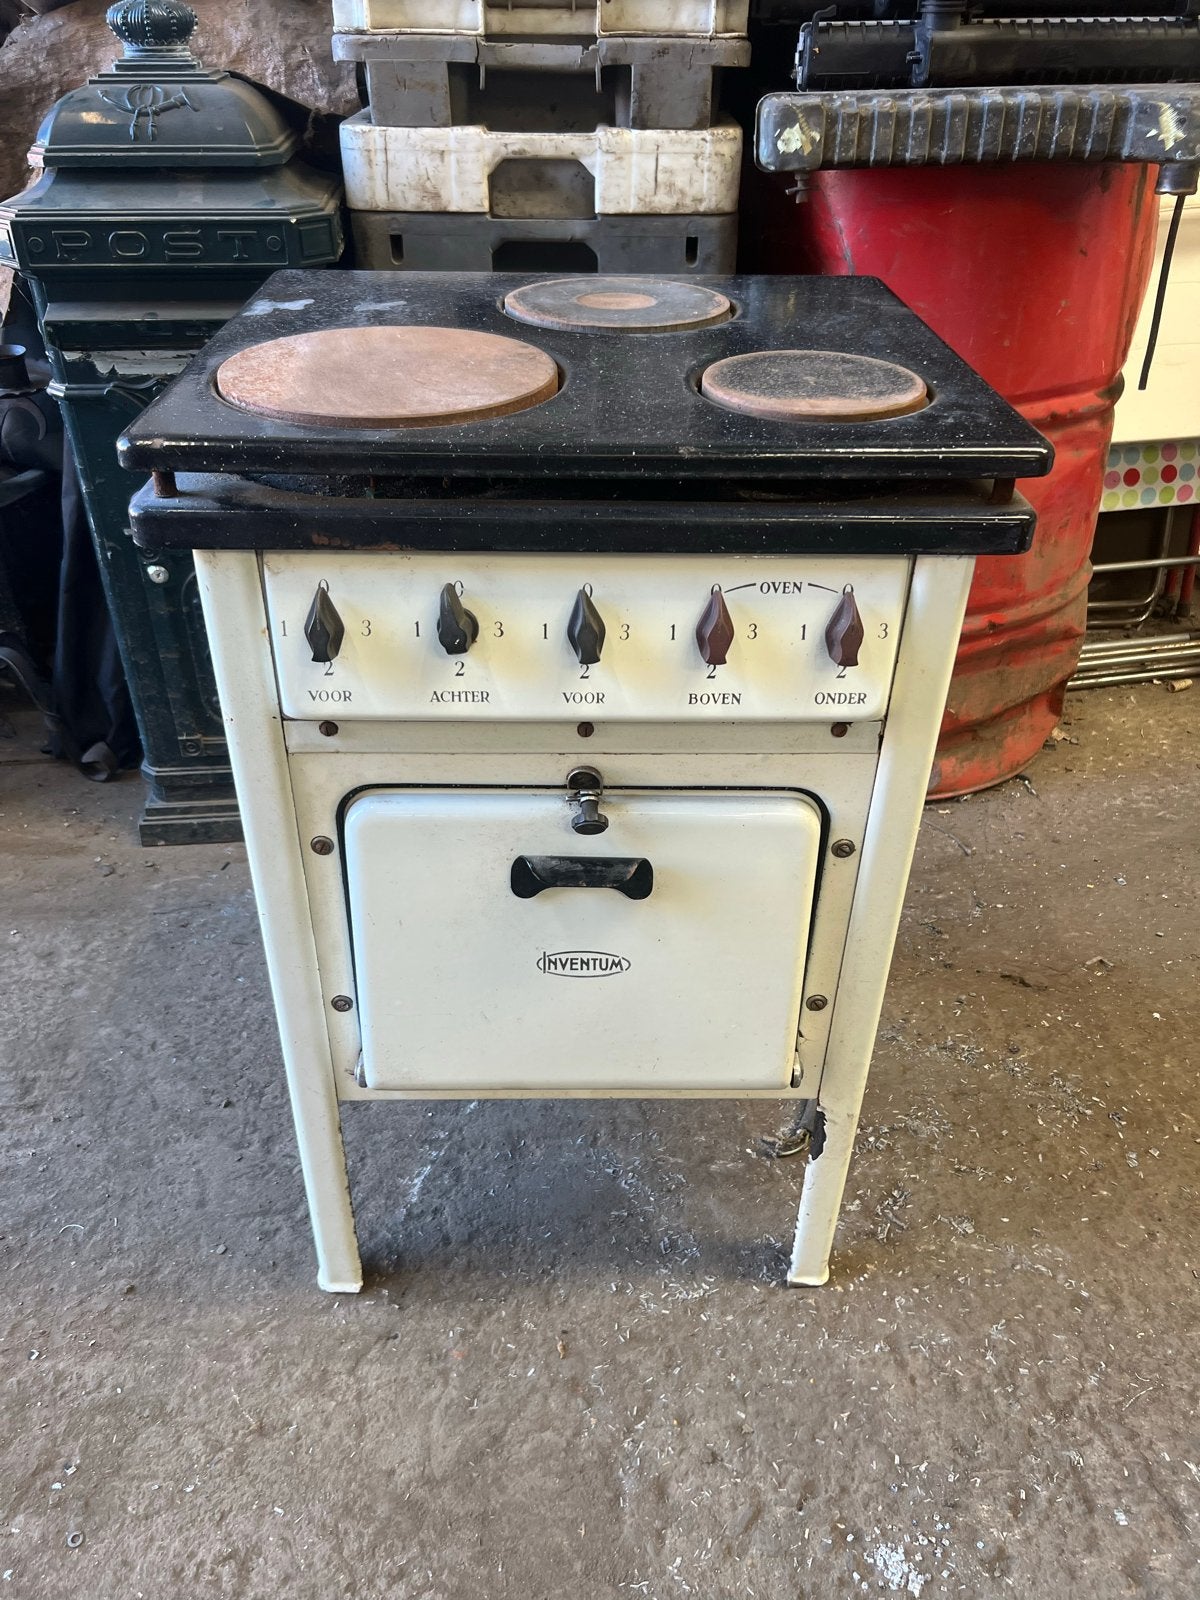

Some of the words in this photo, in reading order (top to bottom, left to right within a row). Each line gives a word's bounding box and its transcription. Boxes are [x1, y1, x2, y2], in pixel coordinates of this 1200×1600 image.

[51, 229, 258, 261] POST
[760, 581, 803, 594] OVEN
[281, 621, 288, 637] 1
[361, 619, 372, 637] 3
[414, 620, 421, 638] 1
[494, 621, 505, 638] 3
[542, 623, 548, 640] 1
[619, 623, 631, 641] 3
[670, 624, 676, 641] 1
[747, 623, 758, 640] 3
[801, 624, 807, 641] 1
[878, 622, 889, 640] 3
[323, 661, 334, 676] 2
[455, 661, 465, 677] 2
[579, 663, 590, 679] 2
[706, 664, 717, 679] 2
[308, 690, 353, 702] VOOR
[430, 690, 491, 703] ACHTER
[562, 692, 605, 704] VOOR
[688, 693, 742, 705] BOVEN
[814, 692, 867, 705] ONDER
[542, 951, 624, 974] INVENTUM
